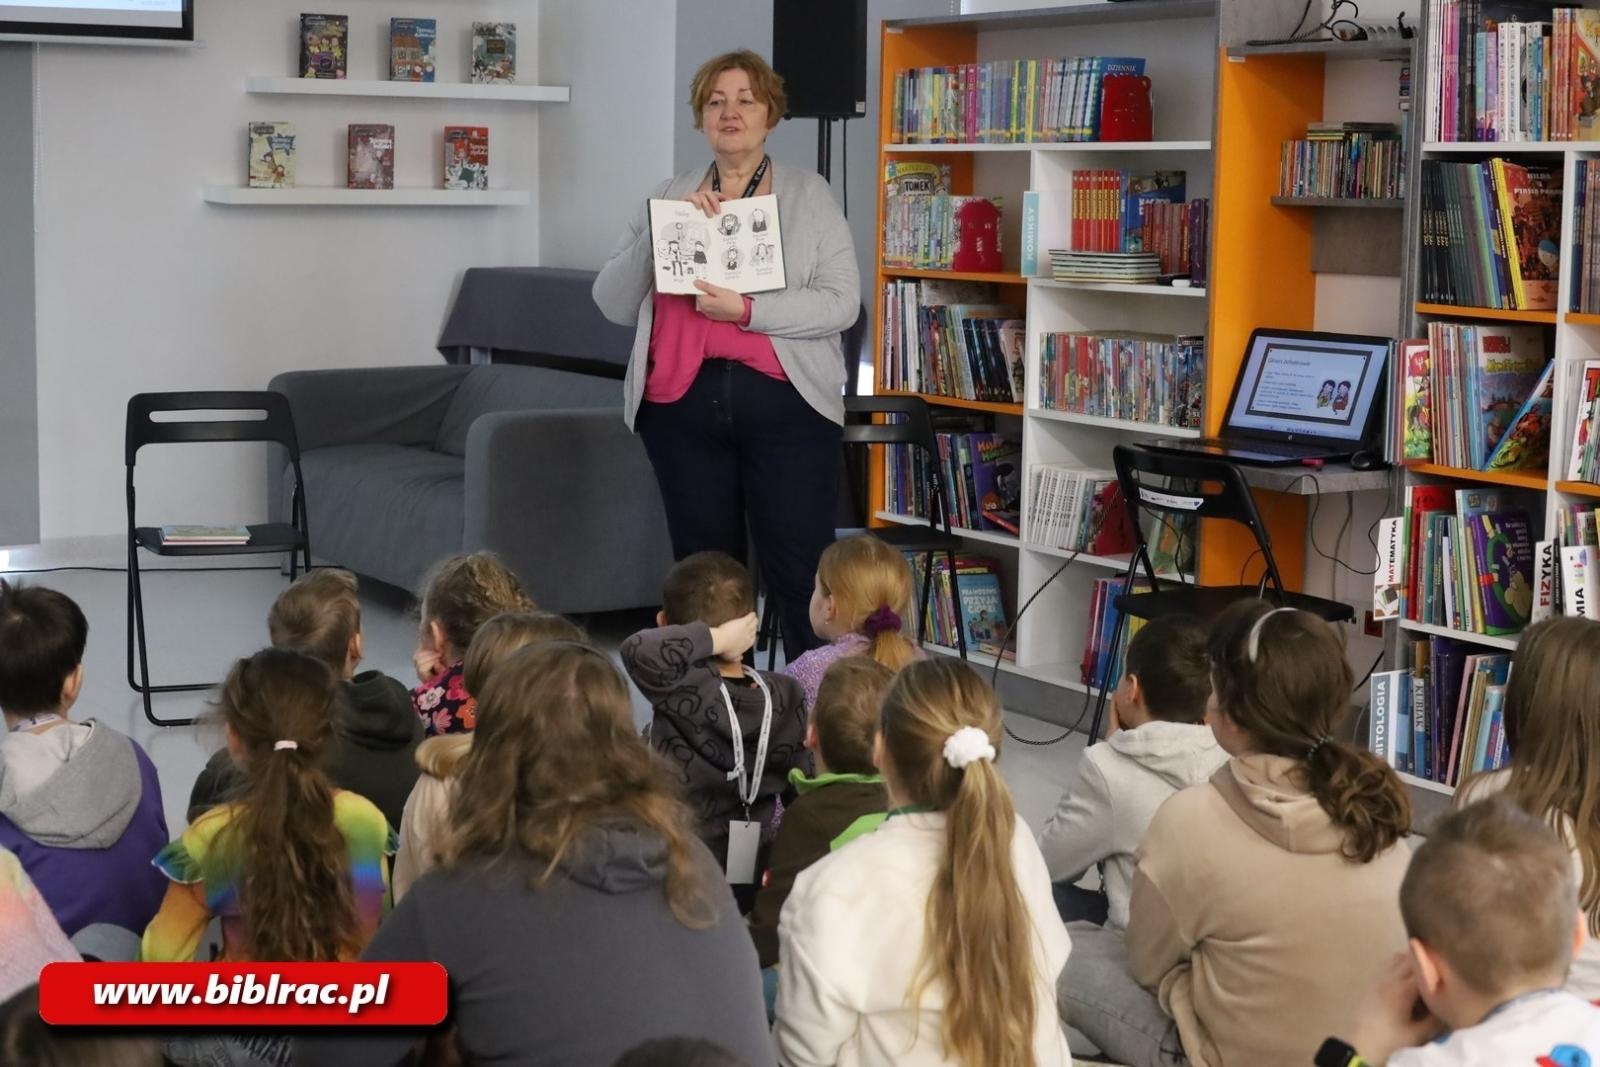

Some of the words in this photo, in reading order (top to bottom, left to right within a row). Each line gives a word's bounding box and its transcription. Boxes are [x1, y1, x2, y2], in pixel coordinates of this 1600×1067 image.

[1107, 64, 1137, 72] DZIENNIK
[904, 181, 930, 191] TOMEK
[1026, 207, 1035, 261] KOMIKSY
[1388, 519, 1397, 582] MATEMATYKA
[1540, 544, 1552, 607] FIZYKA
[1415, 686, 1424, 729] KUBIAK
